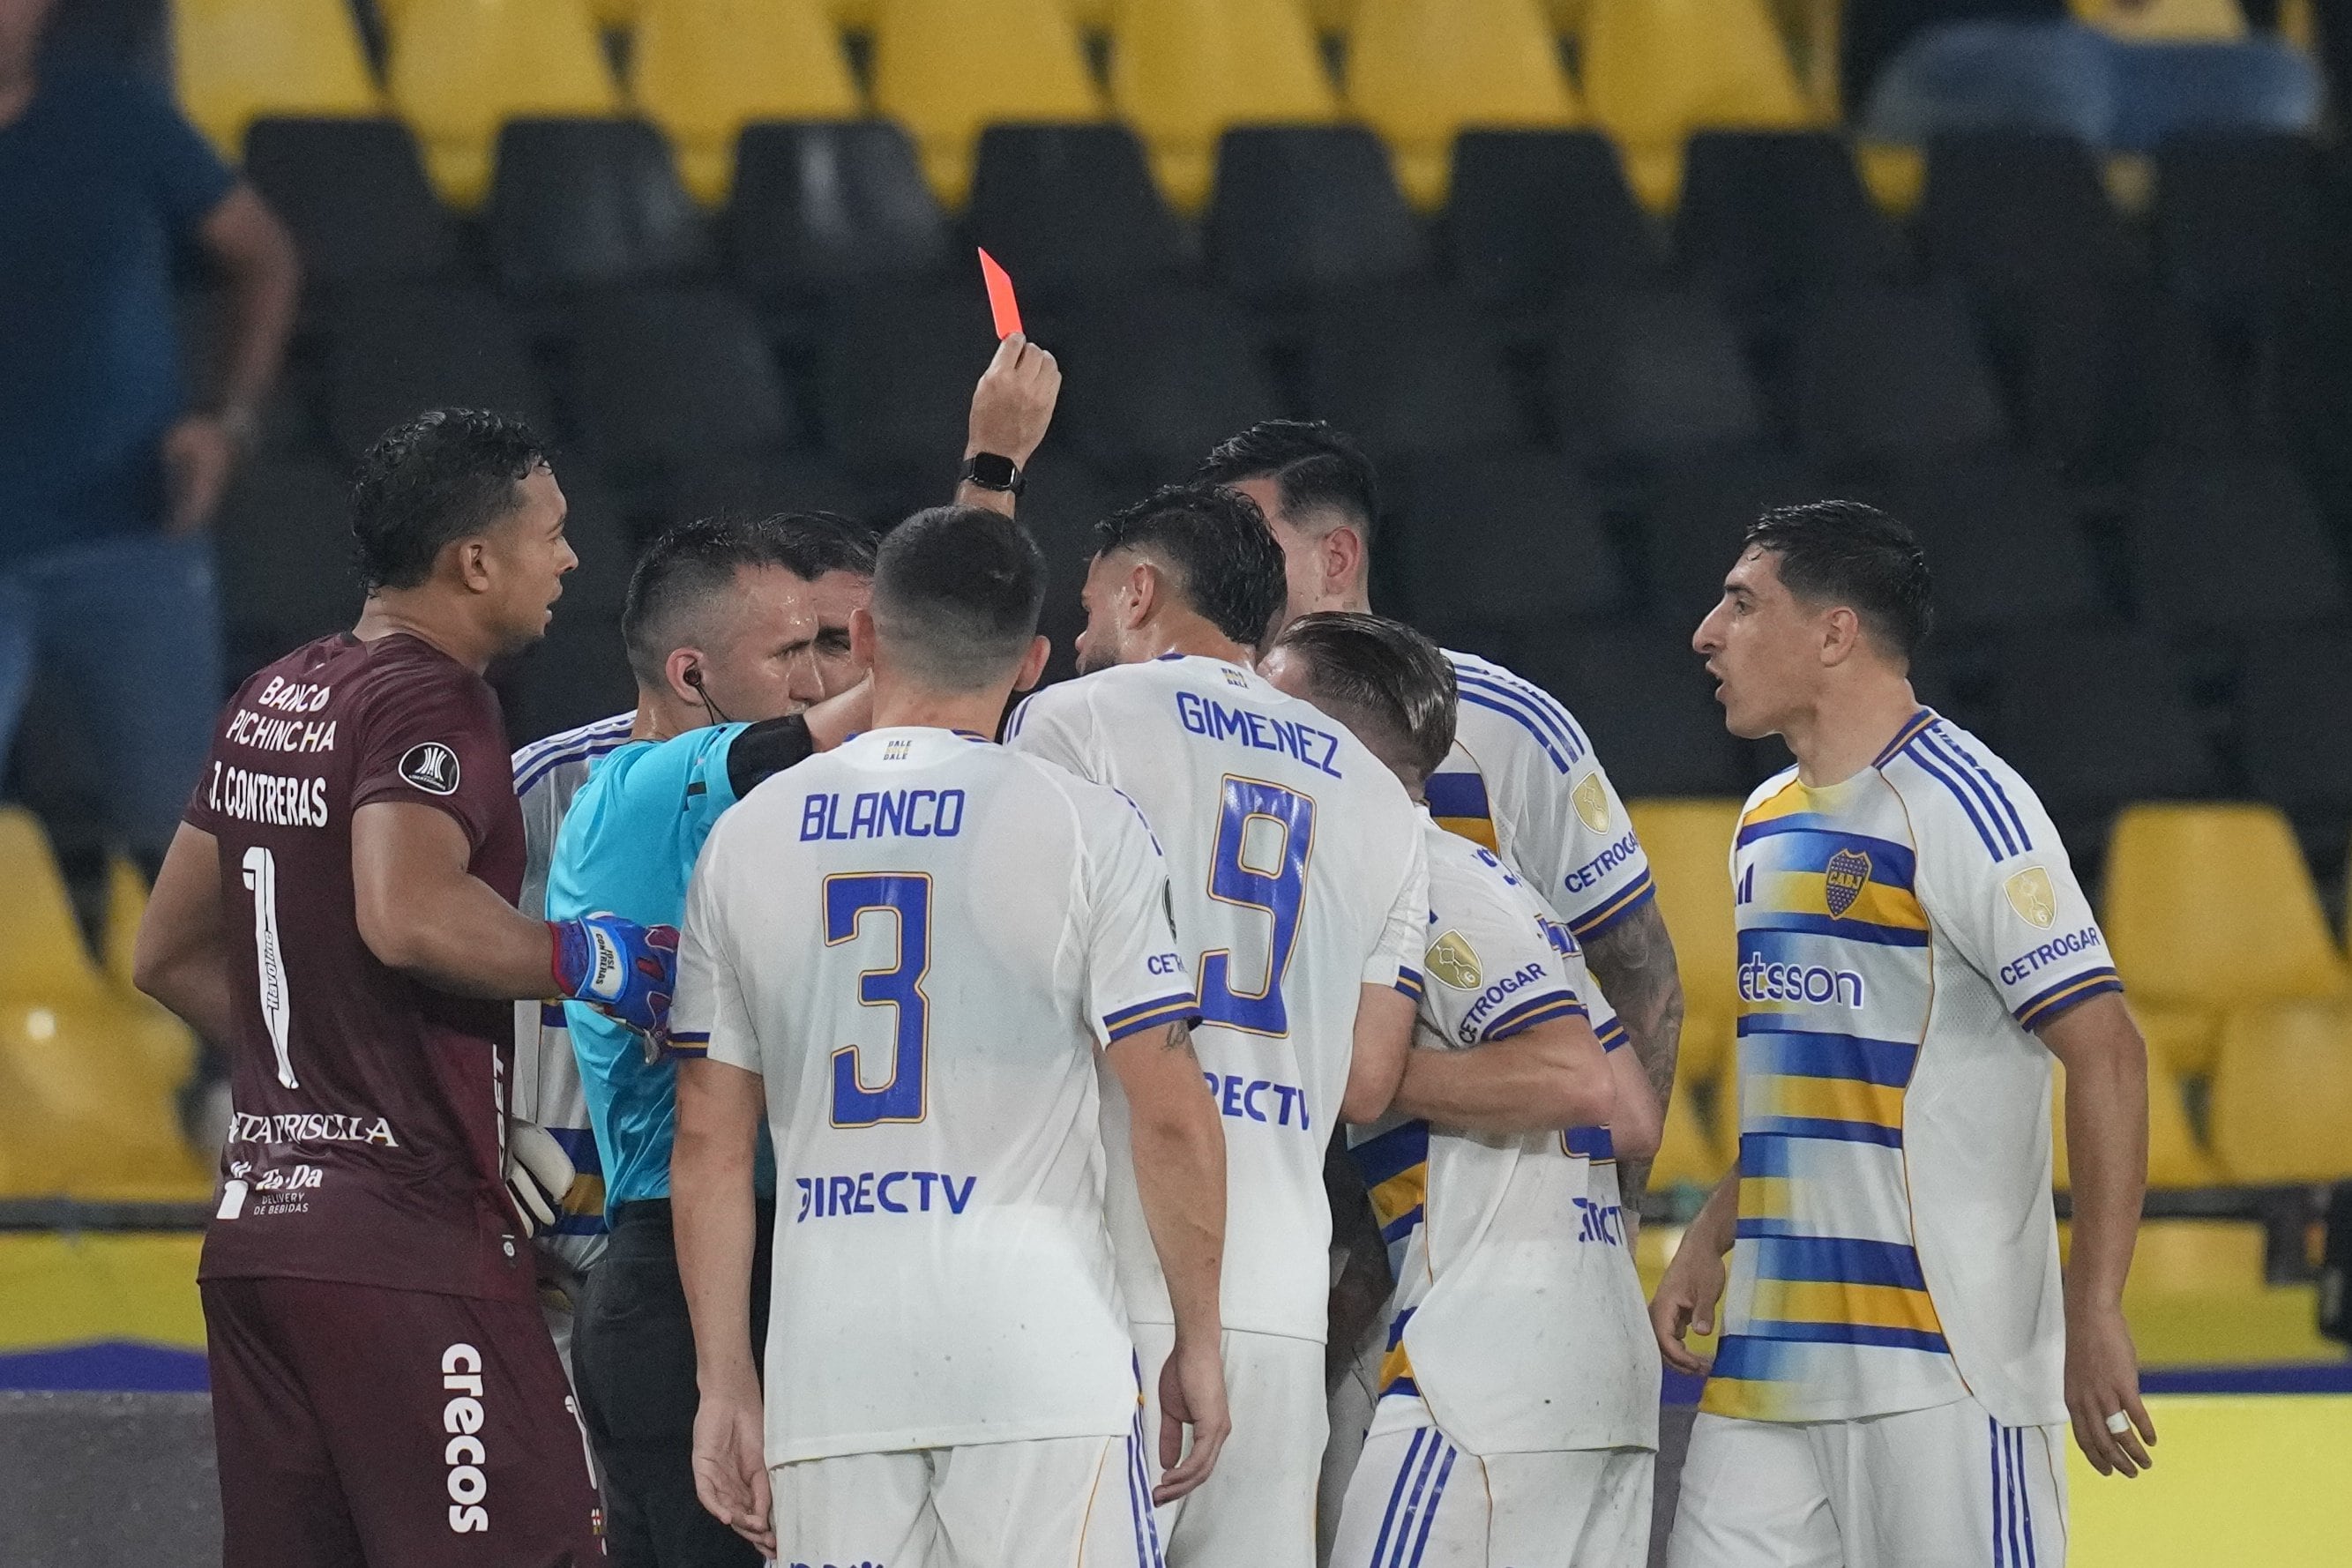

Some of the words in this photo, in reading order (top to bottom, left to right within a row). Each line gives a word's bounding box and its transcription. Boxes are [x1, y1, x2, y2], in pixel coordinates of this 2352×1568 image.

[258, 676, 332, 713] BANCO
[226, 709, 337, 752] PICHINCHA
[1176, 691, 1343, 779] GIMENEZ
[210, 760, 222, 812] J.
[225, 766, 328, 827] CONTRERAS
[799, 789, 965, 841] BLANCO
[1197, 773, 1316, 1038] 9
[1828, 870, 1863, 889] CABJ
[243, 847, 299, 1089] 1
[266, 930, 280, 1010] Havoline
[1738, 952, 1865, 1010] etsson
[2000, 927, 2101, 986] CETROGAR
[823, 871, 933, 1129] 3
[1459, 962, 1548, 1044] CETROGAR
[254, 1206, 265, 1215] DE
[268, 1203, 309, 1214] BEBIDAS
[262, 1192, 304, 1206] DELIVERY
[796, 1171, 977, 1223] DIRECTV
[442, 1342, 489, 1534] crecos
